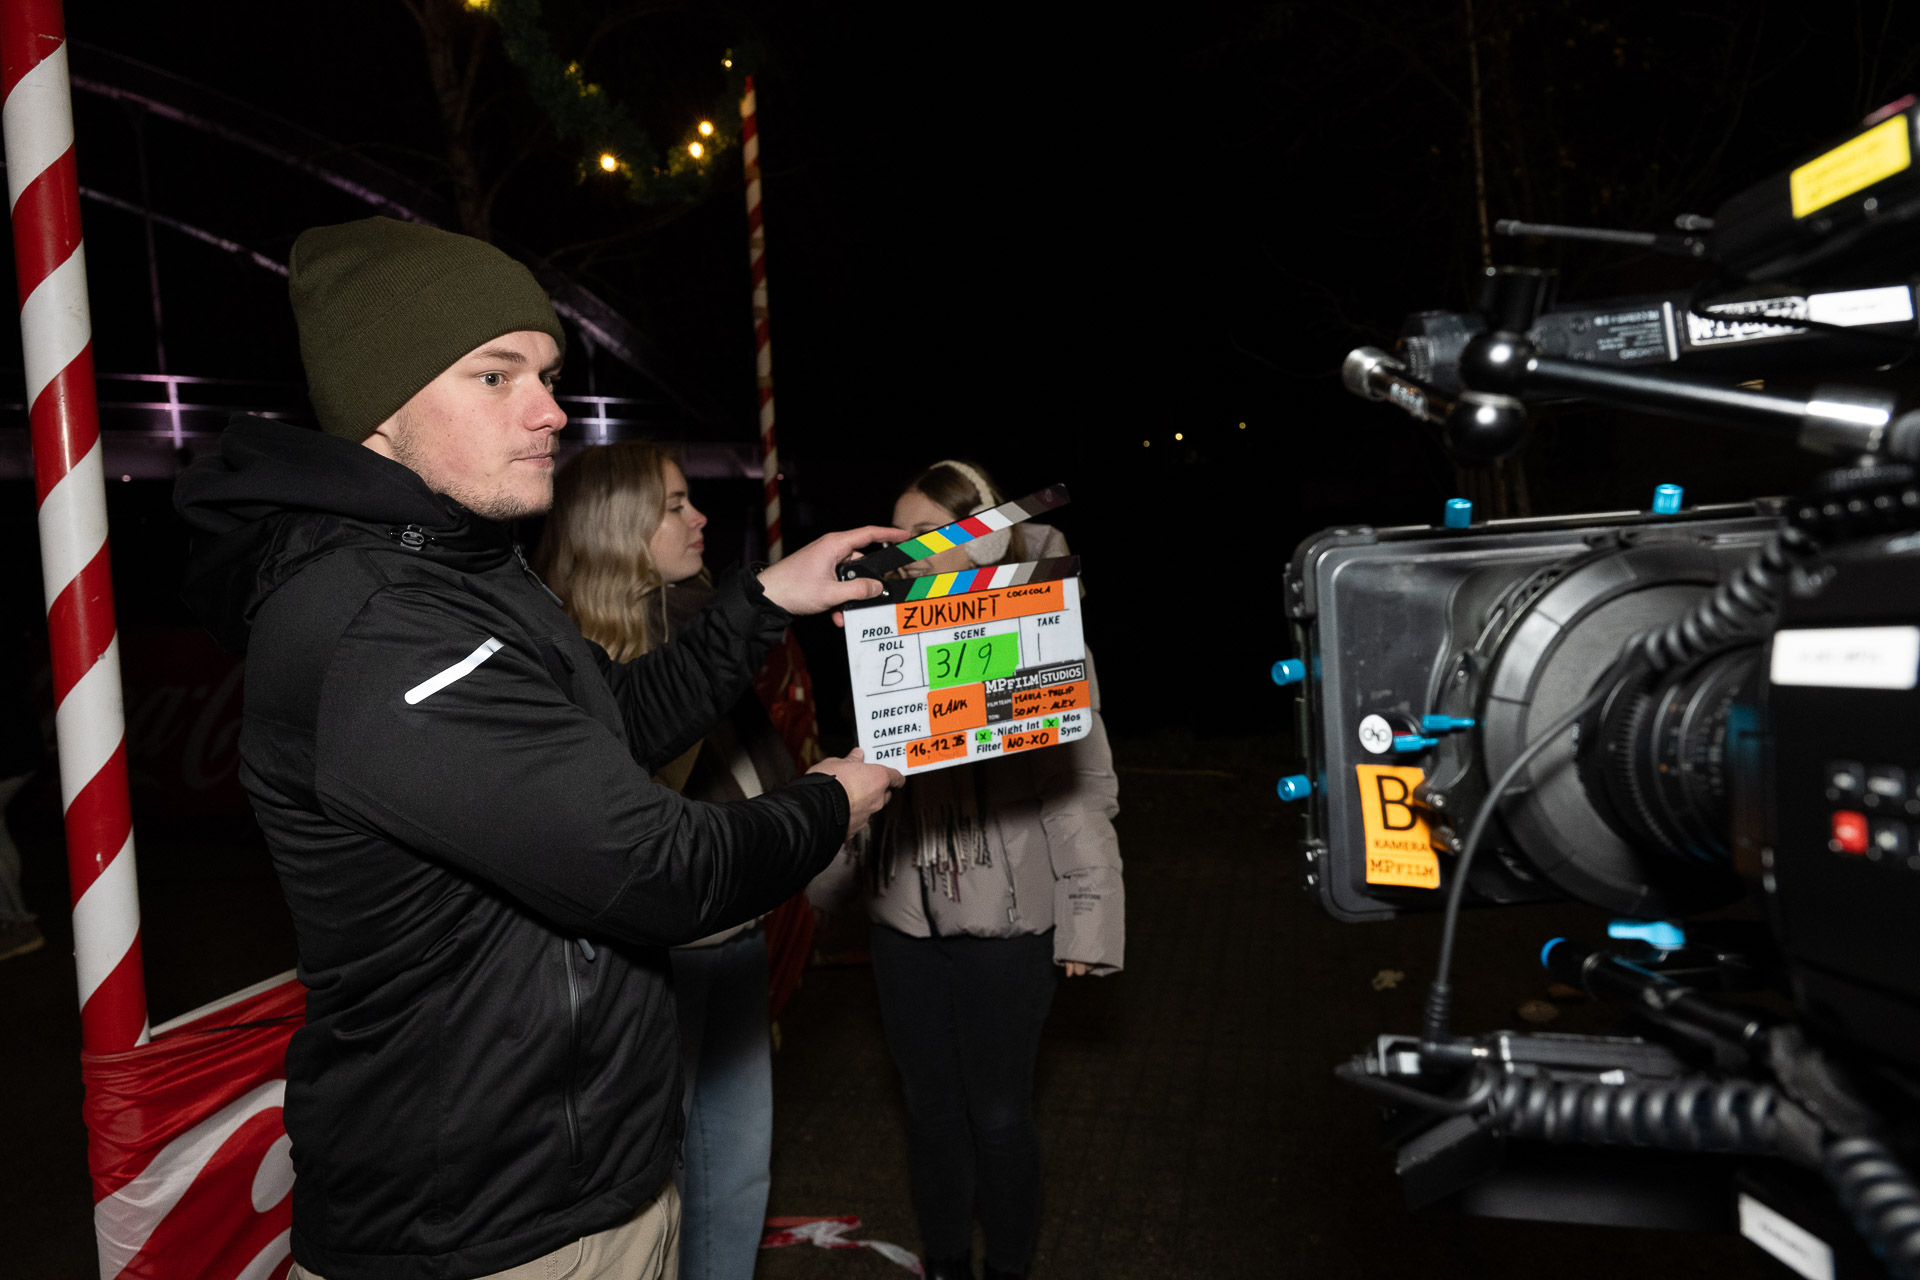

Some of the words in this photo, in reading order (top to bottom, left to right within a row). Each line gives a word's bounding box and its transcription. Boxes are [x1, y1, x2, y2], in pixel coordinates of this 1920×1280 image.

[1037, 615, 1061, 627] TAKE
[862, 626, 894, 639] PROD.
[954, 627, 986, 641] SCENE
[878, 640, 905, 652] ROLL
[881, 653, 904, 687] B
[985, 674, 1040, 694] MPFILM
[1041, 667, 1081, 684] STUDIOS
[871, 702, 928, 720] DIRECTOR:
[1062, 714, 1081, 723] Mos
[873, 723, 922, 739] CAMERA:
[1026, 721, 1040, 731] Int
[1060, 725, 1082, 737] Sync
[876, 747, 906, 760] DATE:
[976, 742, 1002, 754] Filter
[1376, 774, 1417, 831] B
[1374, 840, 1429, 851] KAMERA
